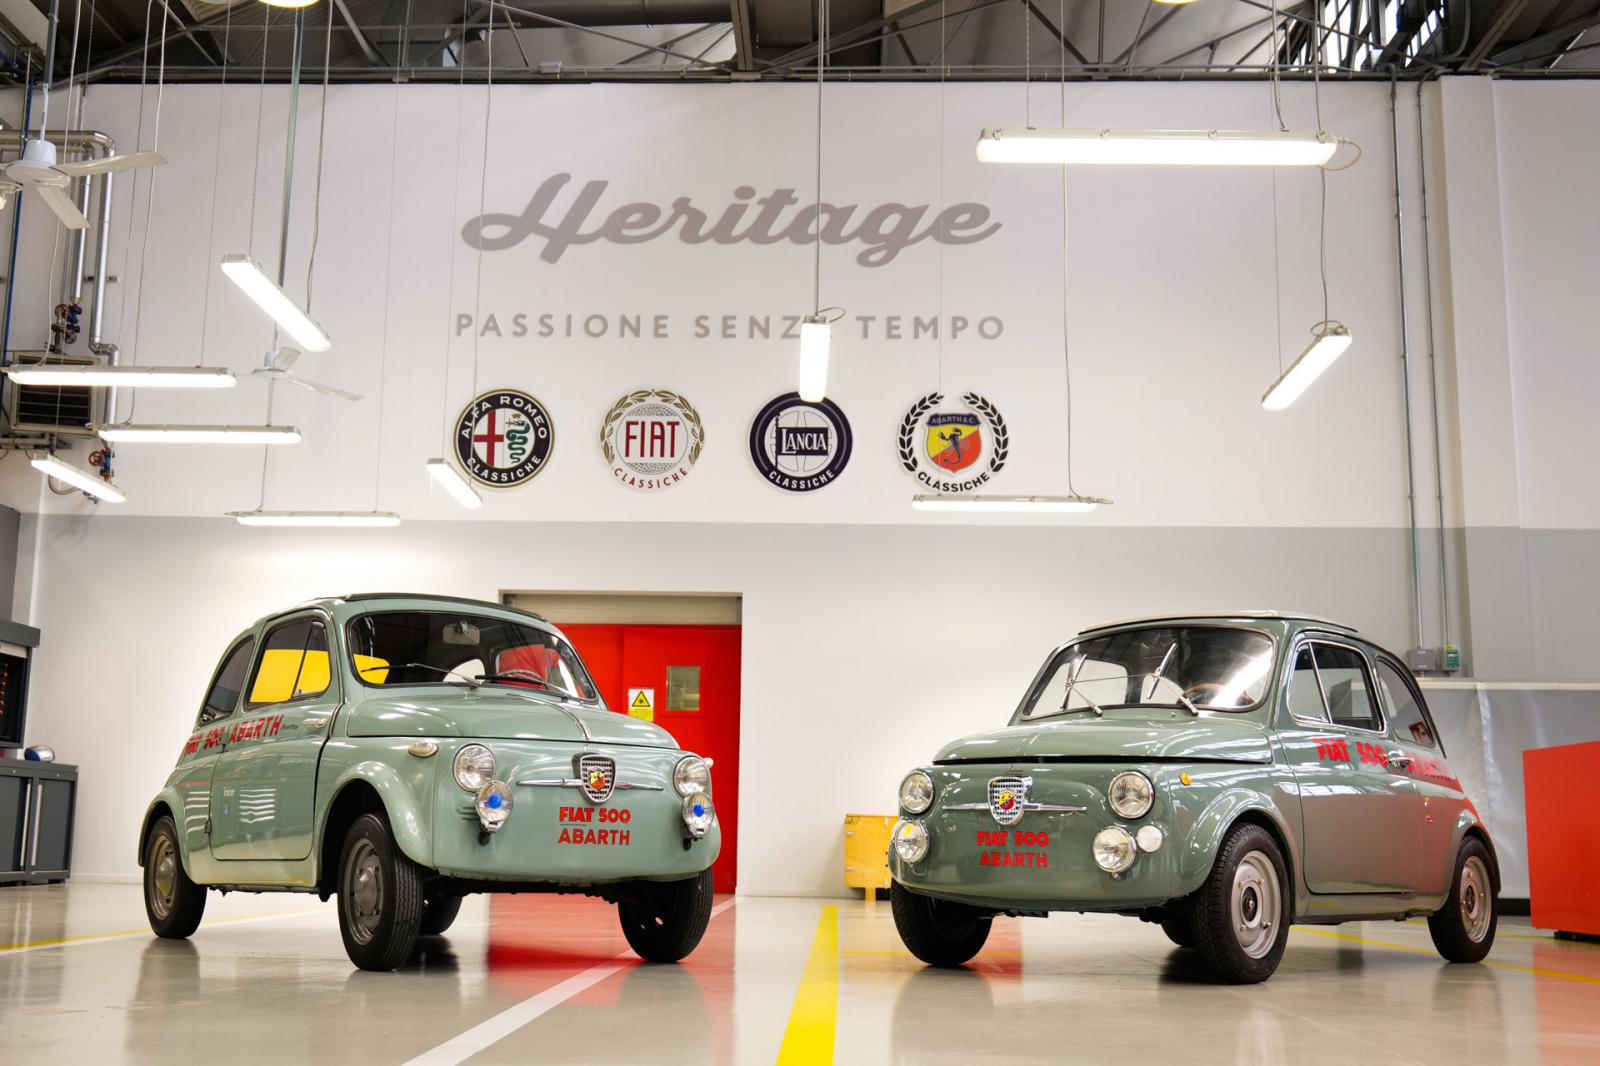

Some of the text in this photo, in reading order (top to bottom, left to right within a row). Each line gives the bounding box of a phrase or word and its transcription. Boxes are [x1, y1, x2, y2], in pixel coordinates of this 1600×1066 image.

[461, 171, 1003, 268] Heritage
[456, 313, 1005, 340] PASSIONE SENZ TEMPO
[461, 395, 548, 440] ALFA ROMEO
[931, 416, 962, 424] ABARTH
[624, 420, 680, 458] FIAT
[781, 428, 828, 455] LANCIA
[466, 454, 543, 483] CLASSICHE
[613, 467, 690, 489] CLASSICHE
[768, 469, 836, 489] CLASSICHE
[917, 471, 991, 493] CLASSICHE
[228, 714, 285, 744] ABARTH
[1312, 737, 1351, 763] FIAT
[1355, 741, 1389, 768] 500
[559, 806, 632, 824] FIAT 500
[558, 828, 631, 846] ABARTH
[976, 831, 1050, 847] FIAT 500
[979, 851, 1049, 868] ABARTH
